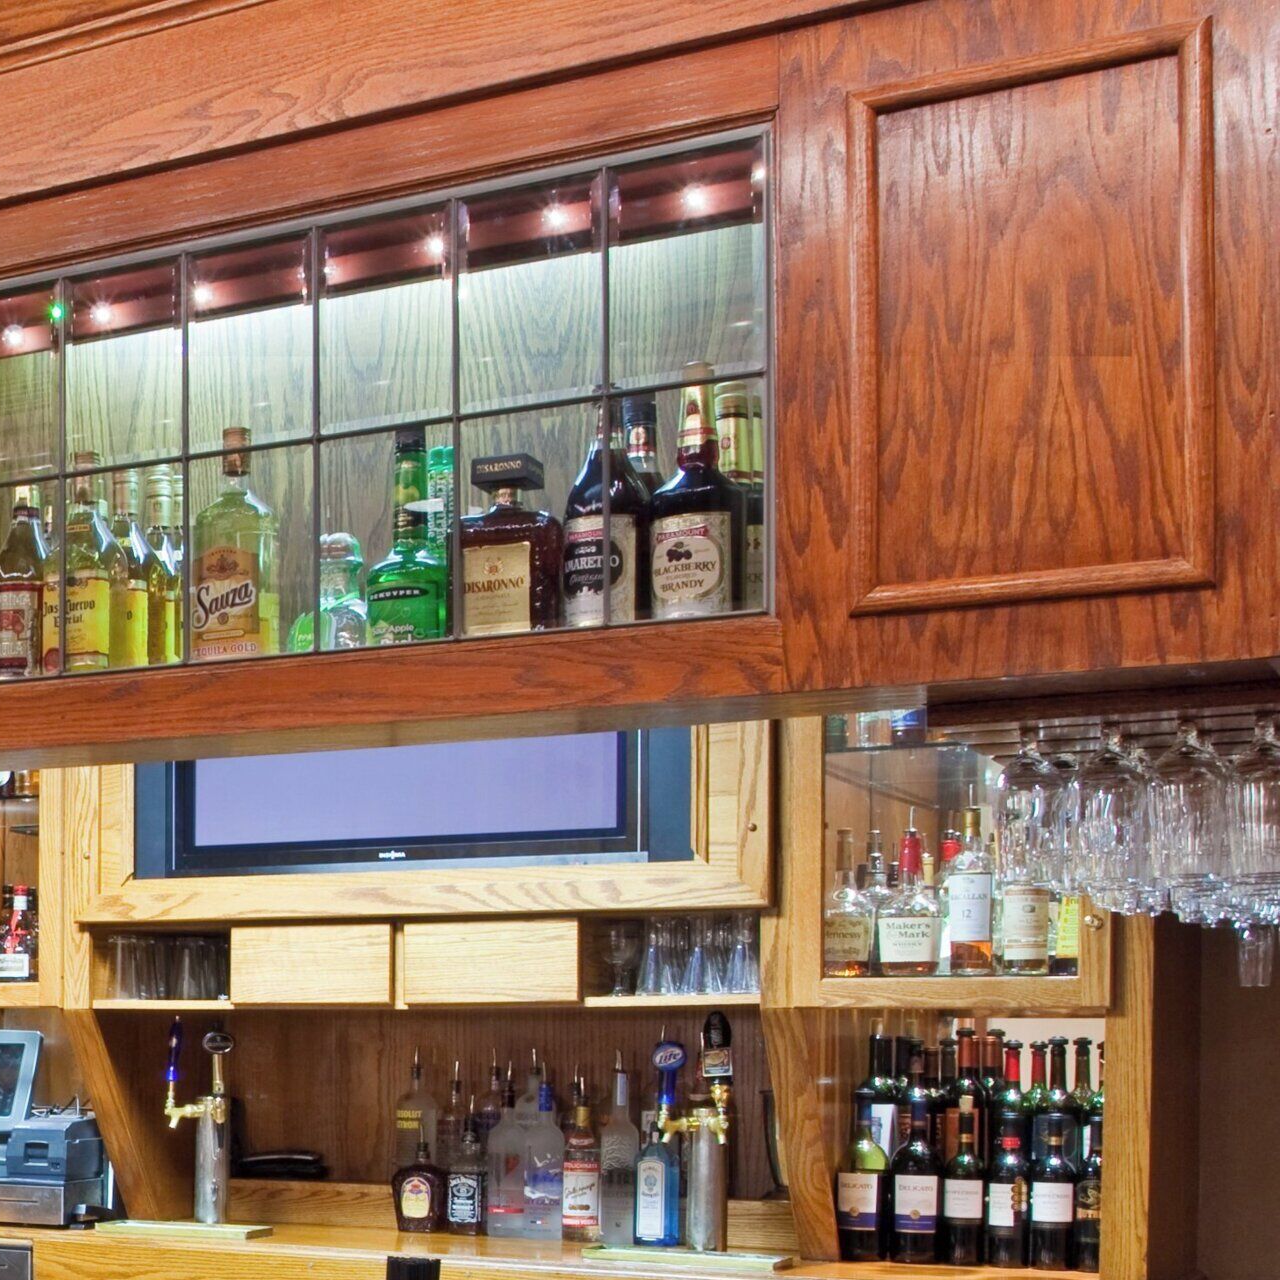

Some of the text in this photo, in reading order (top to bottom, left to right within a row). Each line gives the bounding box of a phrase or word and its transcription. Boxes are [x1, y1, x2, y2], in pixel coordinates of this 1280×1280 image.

[568, 529, 604, 540] PARAMOUN
[657, 527, 705, 541] PARAMOUNT
[565, 555, 620, 572] AMARETO
[654, 560, 717, 577] BLACKBERRY
[463, 576, 520, 594] DISARONNO
[661, 579, 705, 592] BRANDY
[192, 582, 254, 630] Sauza
[388, 623, 415, 634] Apple
[230, 643, 257, 653] GOLD
[962, 908, 972, 919] 12
[886, 922, 931, 930] Maker's
[898, 930, 930, 938] Mark
[657, 1052, 682, 1065] Lite
[396, 1110, 423, 1119] BSOLUT
[898, 1184, 934, 1192] DELICATO
